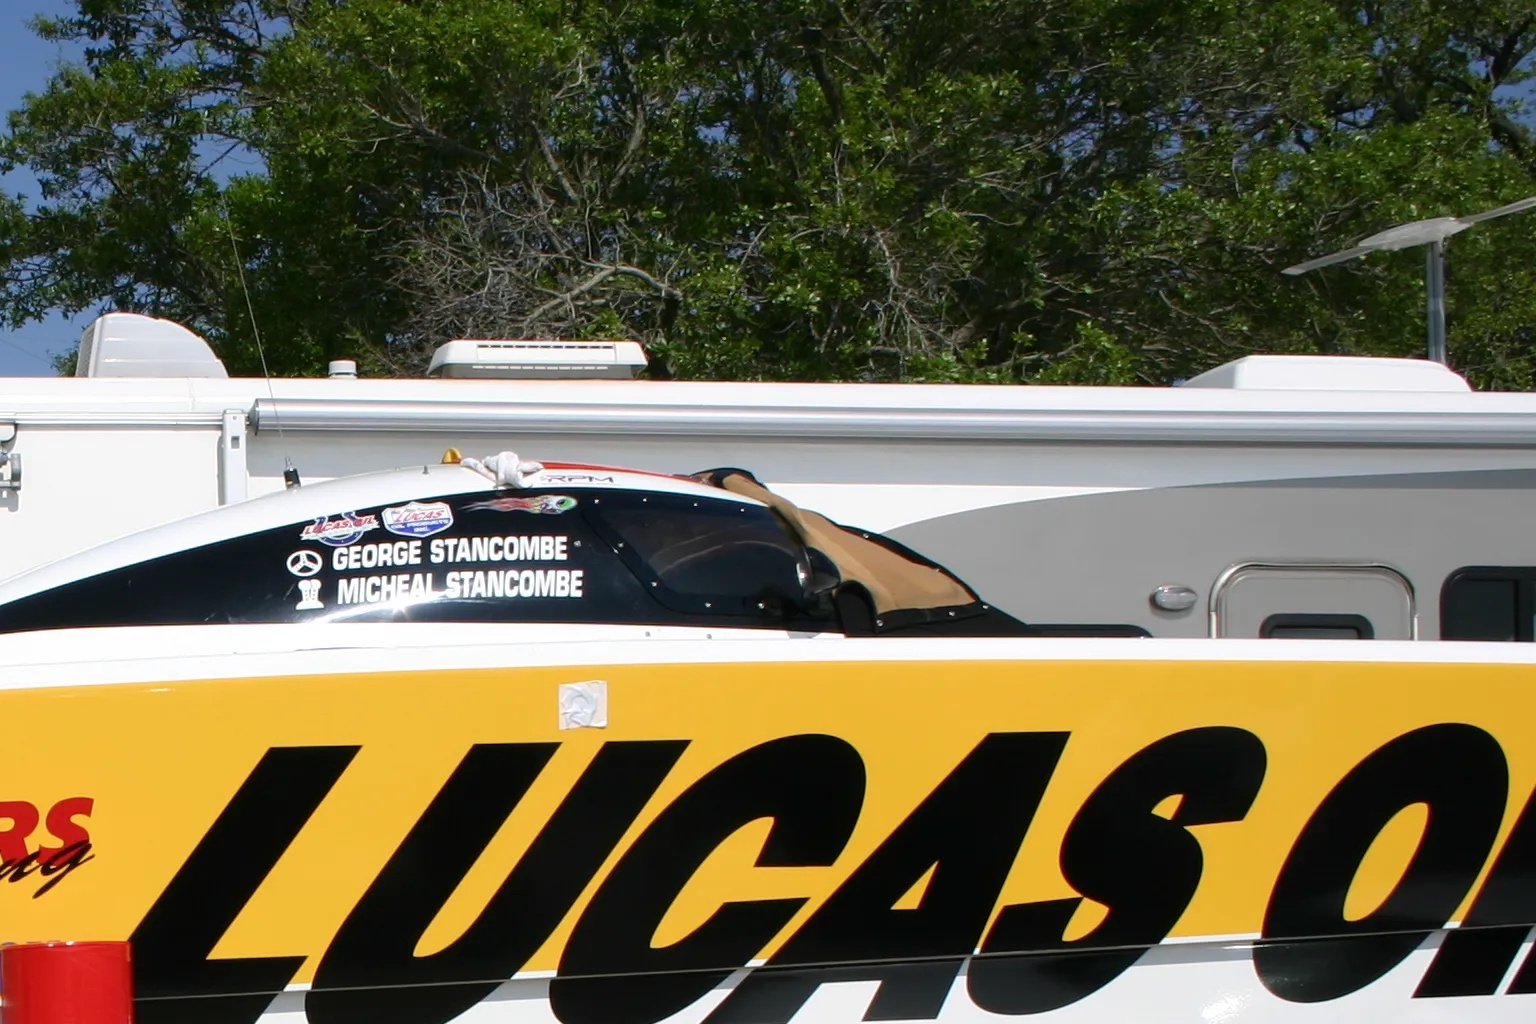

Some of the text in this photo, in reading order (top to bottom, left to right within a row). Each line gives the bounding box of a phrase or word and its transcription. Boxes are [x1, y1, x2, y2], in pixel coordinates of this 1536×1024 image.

[332, 535, 568, 572] GEORGE STANCOMBE
[337, 569, 584, 605] MICHEAL STANCOMBE
[1252, 722, 1536, 1004] OI
